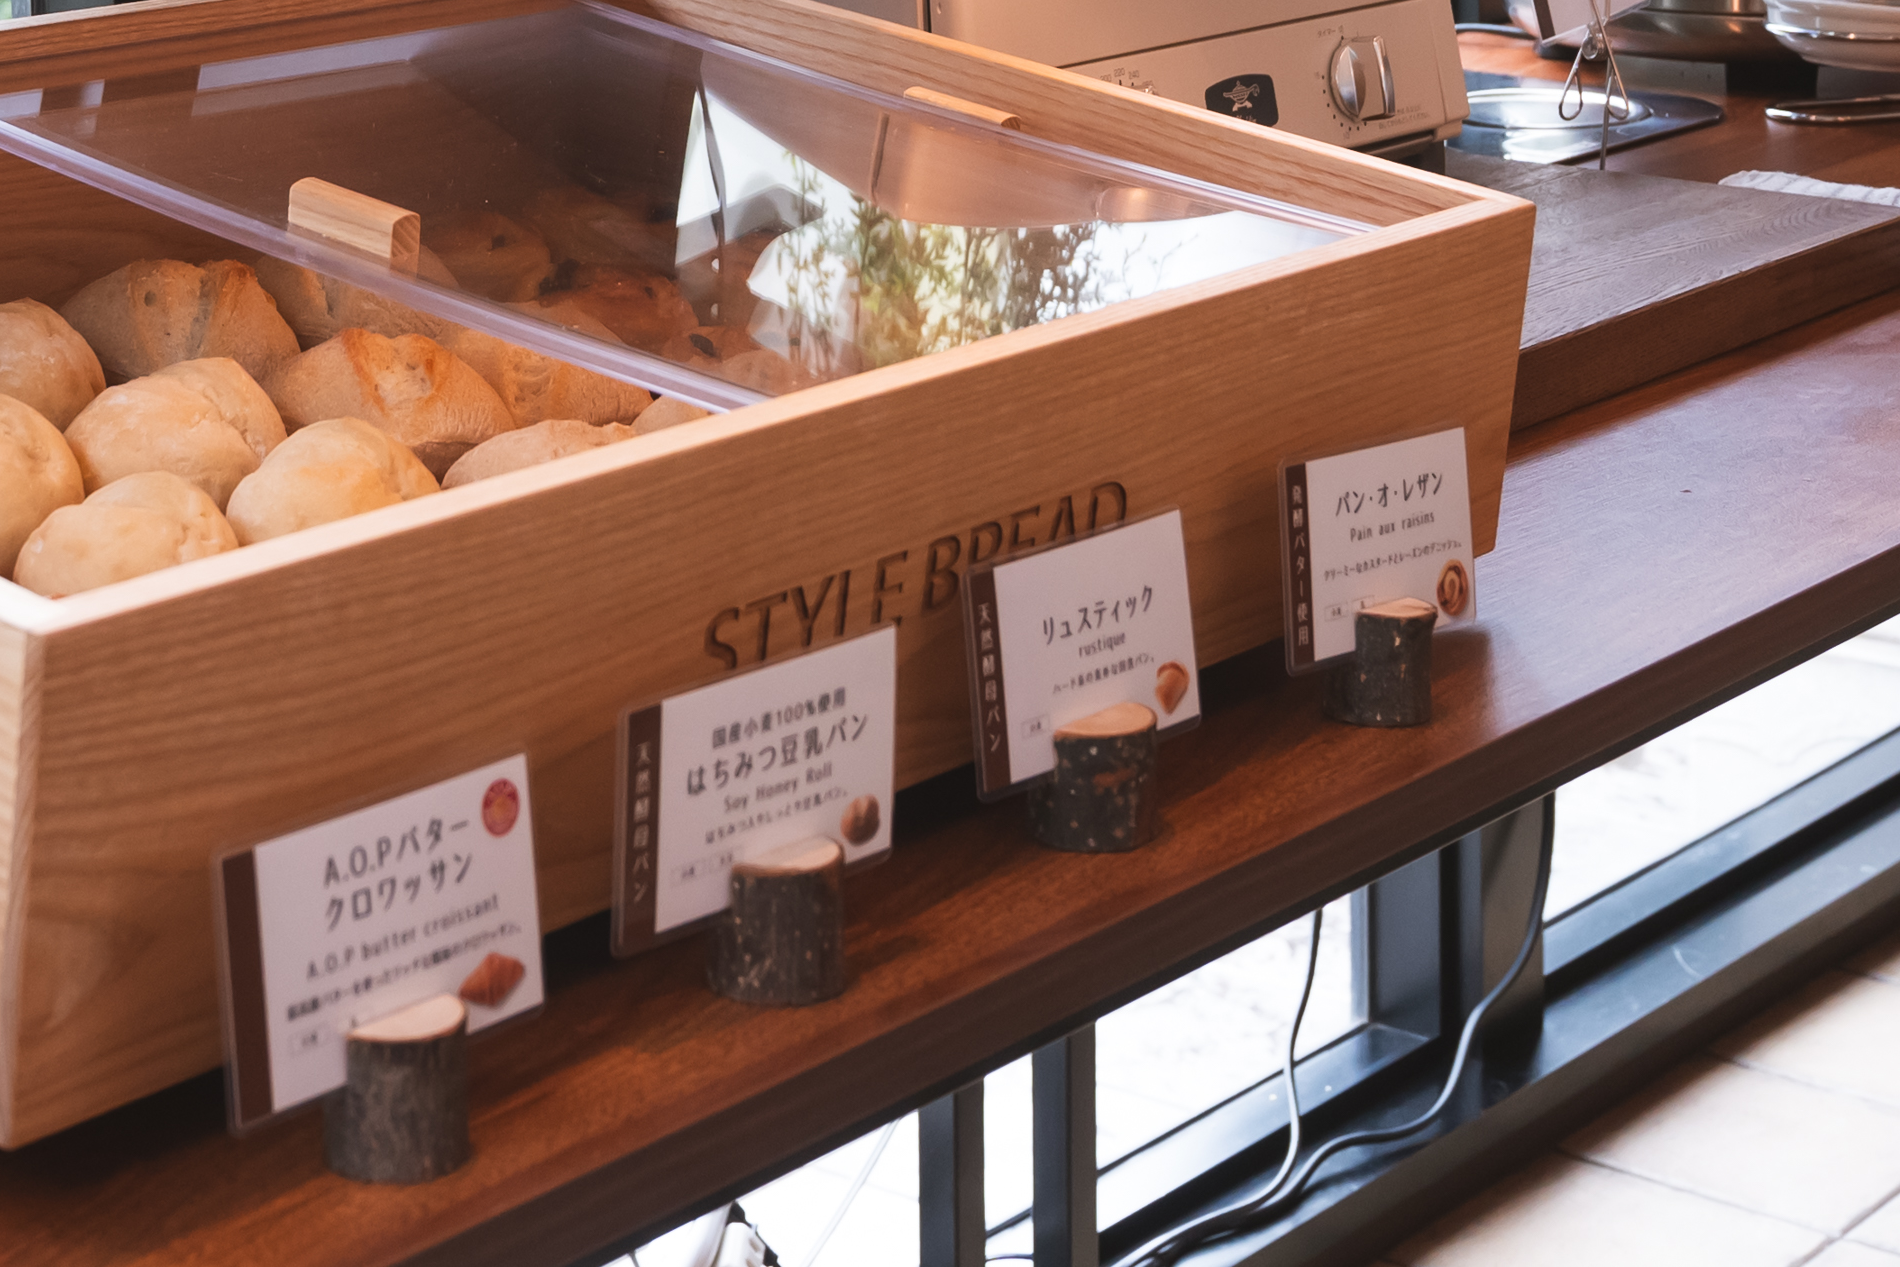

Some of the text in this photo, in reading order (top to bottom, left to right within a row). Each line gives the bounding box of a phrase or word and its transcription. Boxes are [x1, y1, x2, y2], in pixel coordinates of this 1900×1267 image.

[1114, 67, 1125, 78] 220
[1335, 471, 1443, 518] パン・オ・レザン
[1350, 510, 1435, 543] Pain aux raisins
[1042, 584, 1154, 646] リュスティック
[1078, 631, 1127, 660] rustique
[686, 713, 868, 796] はちみつ豆乳パン
[724, 760, 833, 813] Soy Honey Roll
[323, 817, 470, 889] A.O.Pバター
[324, 852, 473, 932] クロワッサン
[306, 892, 500, 980] A.O.P butter croissant
